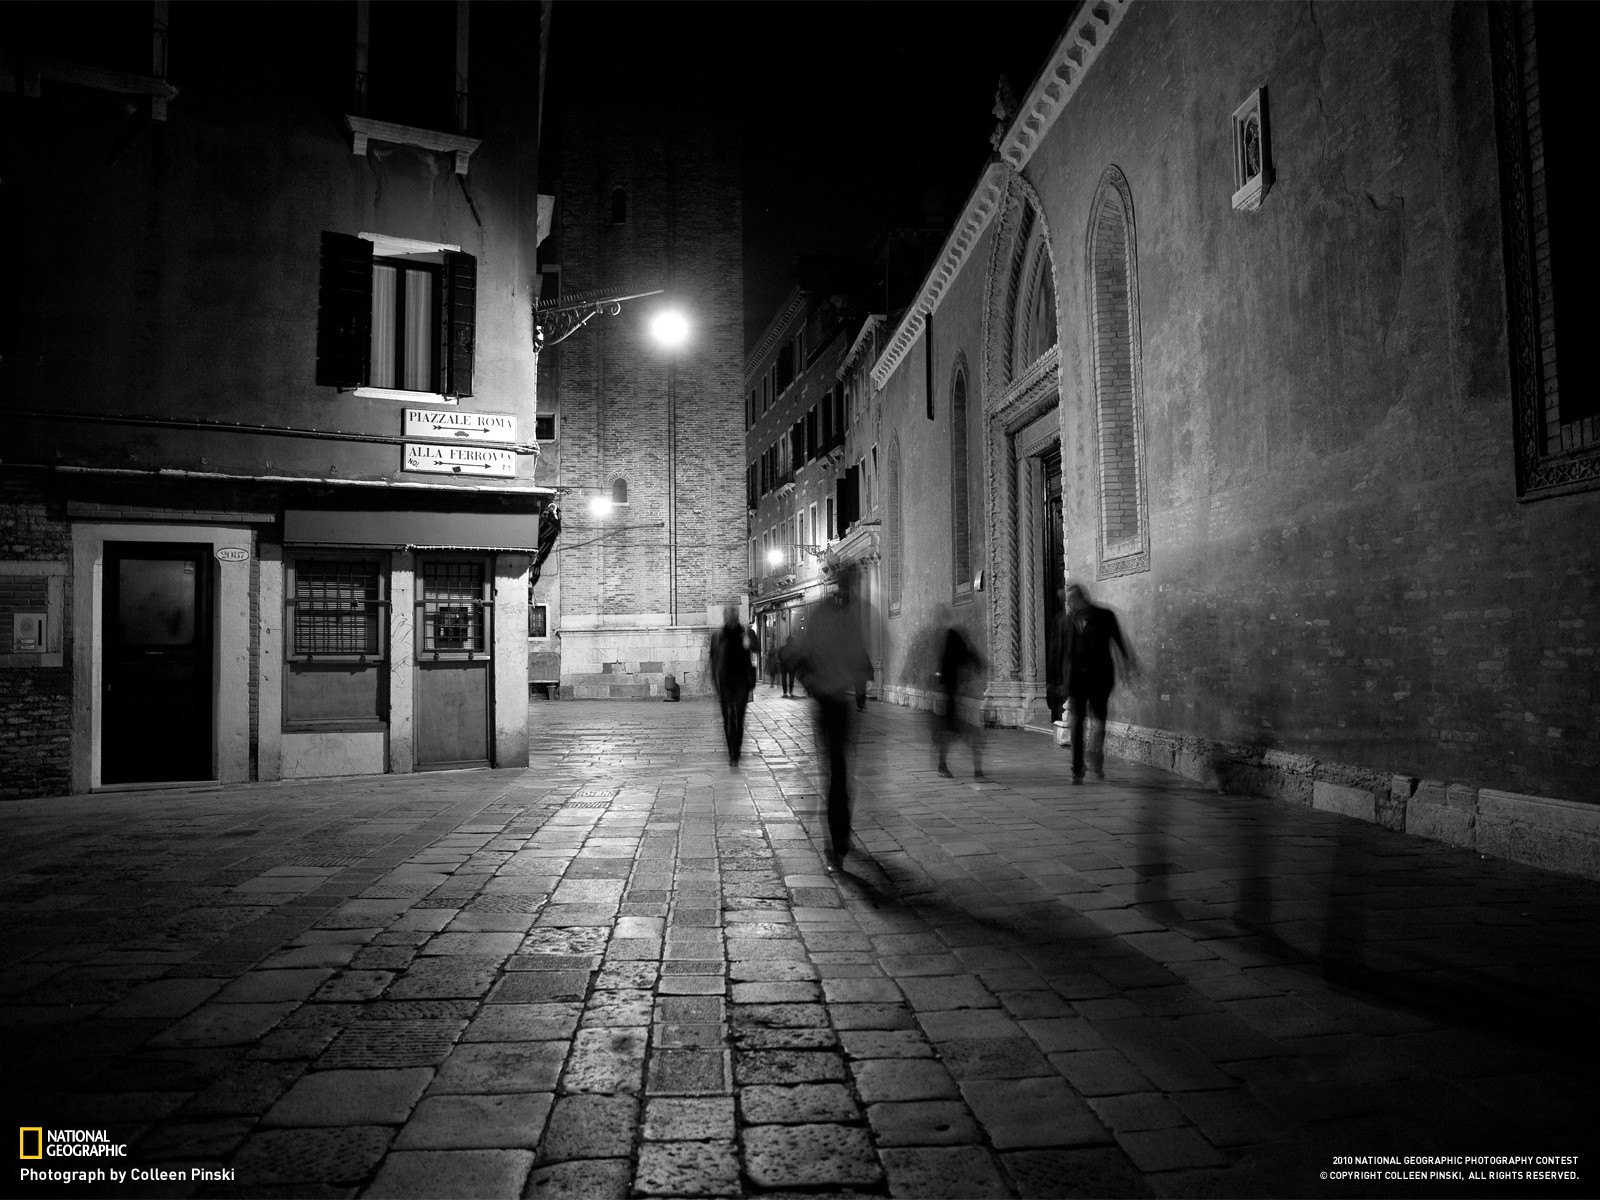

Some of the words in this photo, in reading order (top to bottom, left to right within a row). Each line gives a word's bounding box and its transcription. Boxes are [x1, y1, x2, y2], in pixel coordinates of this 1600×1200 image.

[409, 411, 471, 426] PIAZZALE
[477, 416, 513, 429] ROMA
[409, 447, 443, 459] ALLA
